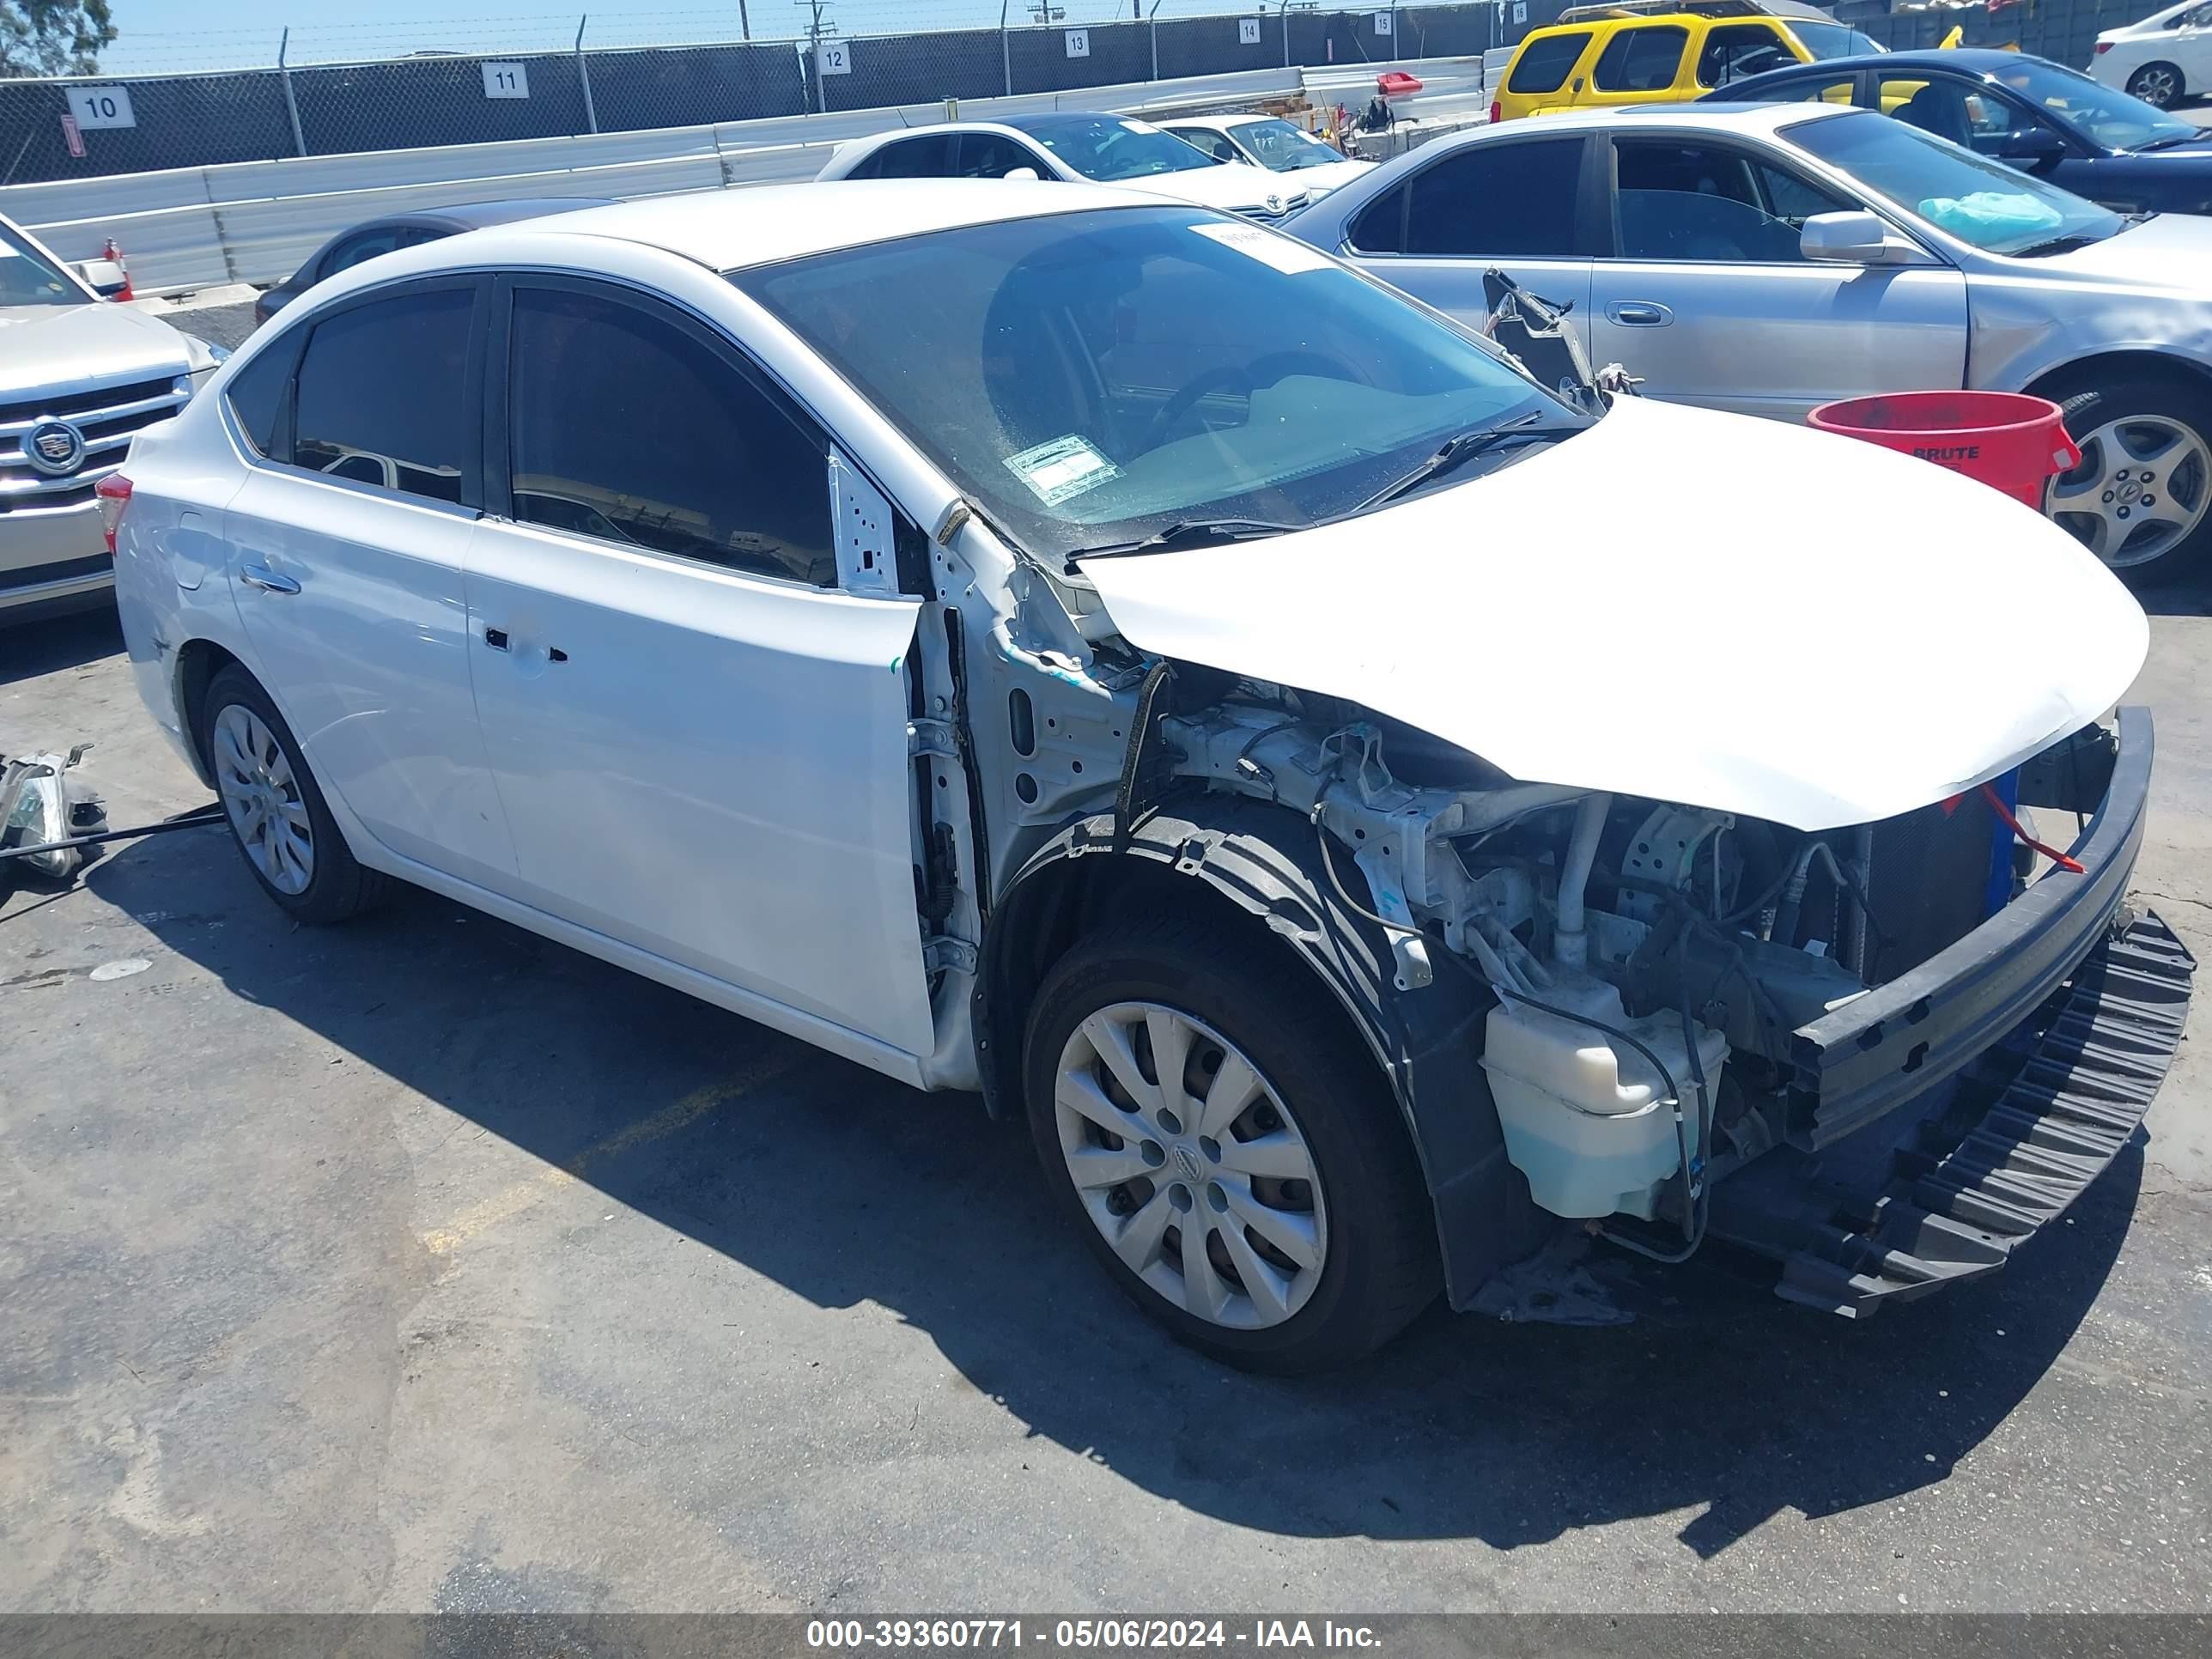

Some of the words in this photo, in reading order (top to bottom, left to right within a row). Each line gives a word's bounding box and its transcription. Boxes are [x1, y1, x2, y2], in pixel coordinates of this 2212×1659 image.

[1379, 18, 1388, 29] 15
[1244, 25, 1255, 38] 14
[1071, 36, 1084, 51] 13
[826, 52, 842, 67] 12
[495, 71, 516, 89] 11
[84, 97, 117, 118] 10
[1912, 447, 1980, 461] BRUTE
